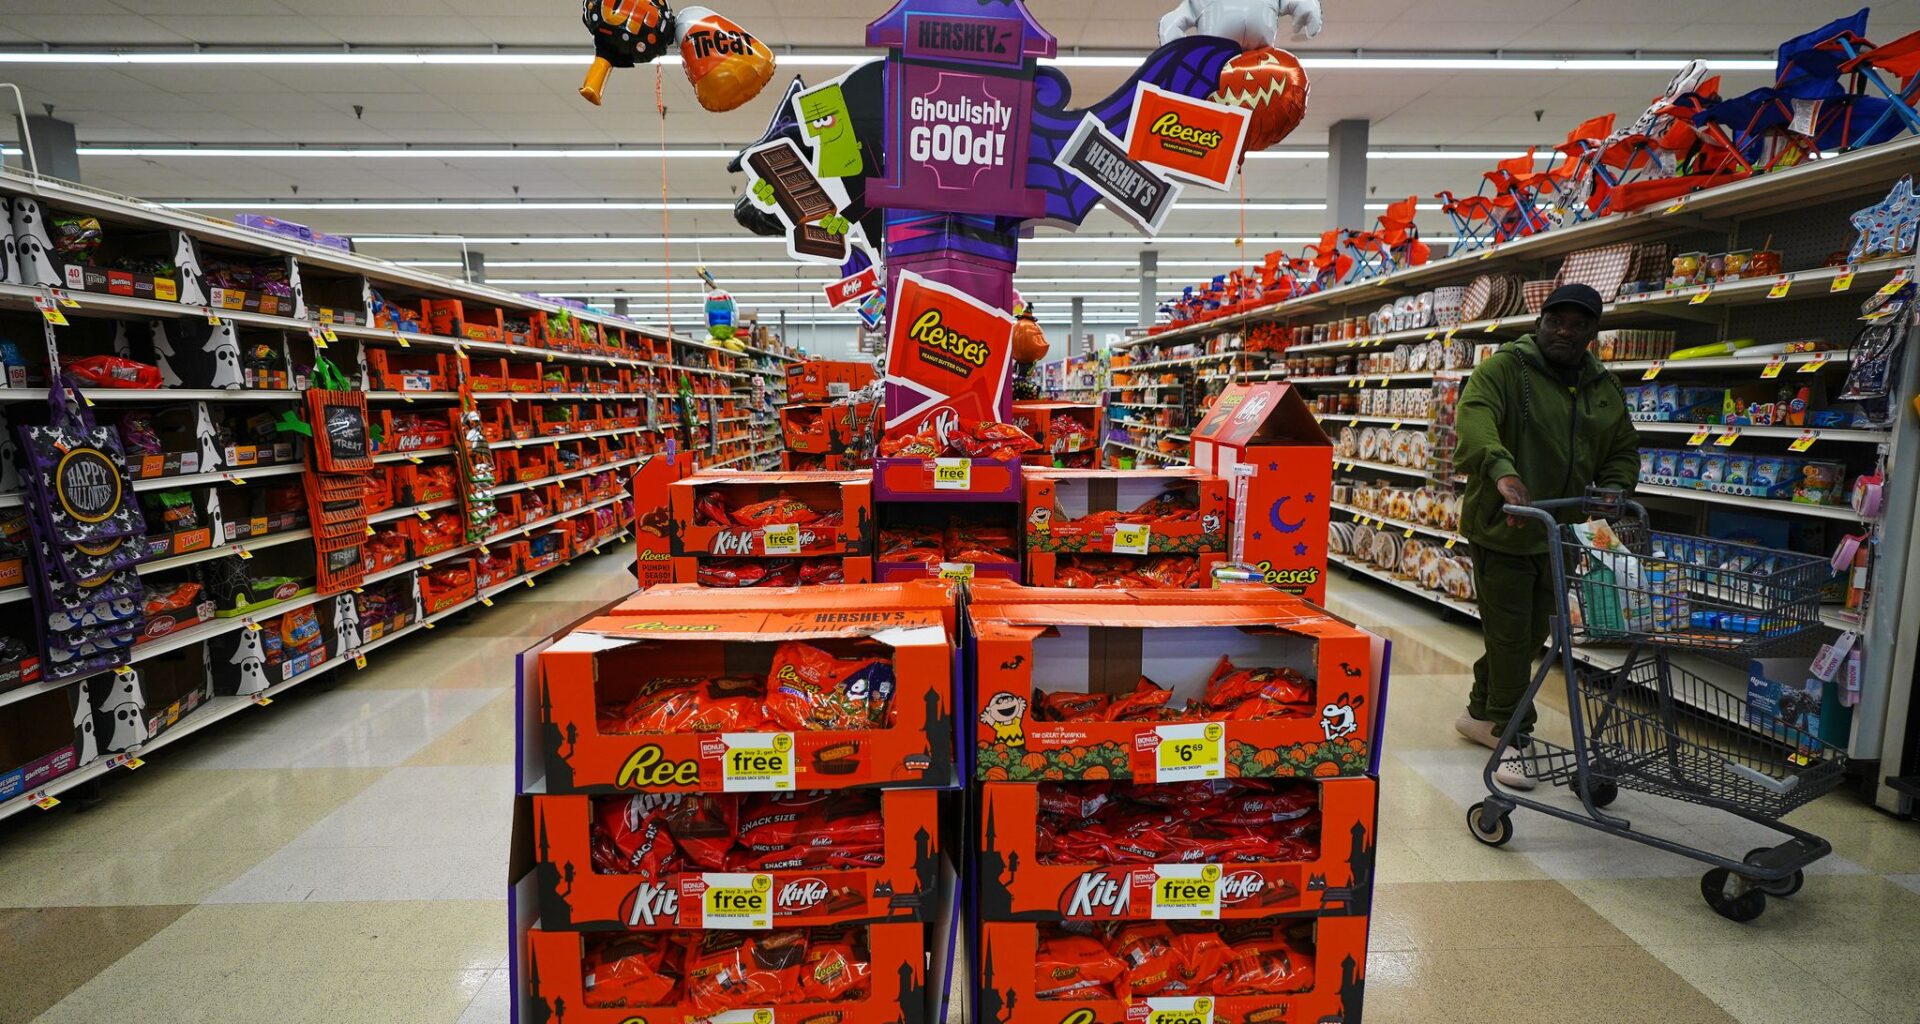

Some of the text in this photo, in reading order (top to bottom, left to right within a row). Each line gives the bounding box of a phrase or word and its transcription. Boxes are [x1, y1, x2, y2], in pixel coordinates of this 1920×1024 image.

[690, 29, 754, 58] Treat
[911, 96, 1012, 131] Ghoulishly
[1151, 112, 1223, 149] Reese's
[1163, 142, 1180, 151] PEANUT
[1178, 146, 1194, 155] BUTTER
[1084, 140, 1157, 208] HERSHEY'S
[68, 268, 80, 278] 40
[909, 310, 990, 366] Reese's
[921, 352, 968, 375] PEANUT BUTTER CUPS
[334, 439, 362, 450] TREAT
[399, 435, 422, 450] KitKat
[67, 461, 107, 488] HAPPY
[939, 467, 965, 478] free
[68, 484, 112, 511] HALLOWEEN
[181, 532, 204, 545] Twix
[768, 534, 795, 545] free
[815, 611, 905, 623] HERSHEY'S
[624, 621, 722, 633] Reese's
[1824, 657, 1838, 677] meow
[1849, 665, 1857, 686] meow
[732, 752, 783, 770] free
[24, 764, 50, 781] Skittles
[774, 813, 797, 822] SIZE
[1182, 850, 1205, 861] KitKat
[778, 882, 828, 906] KitKat
[1163, 881, 1211, 899] free
[713, 891, 762, 909] free
